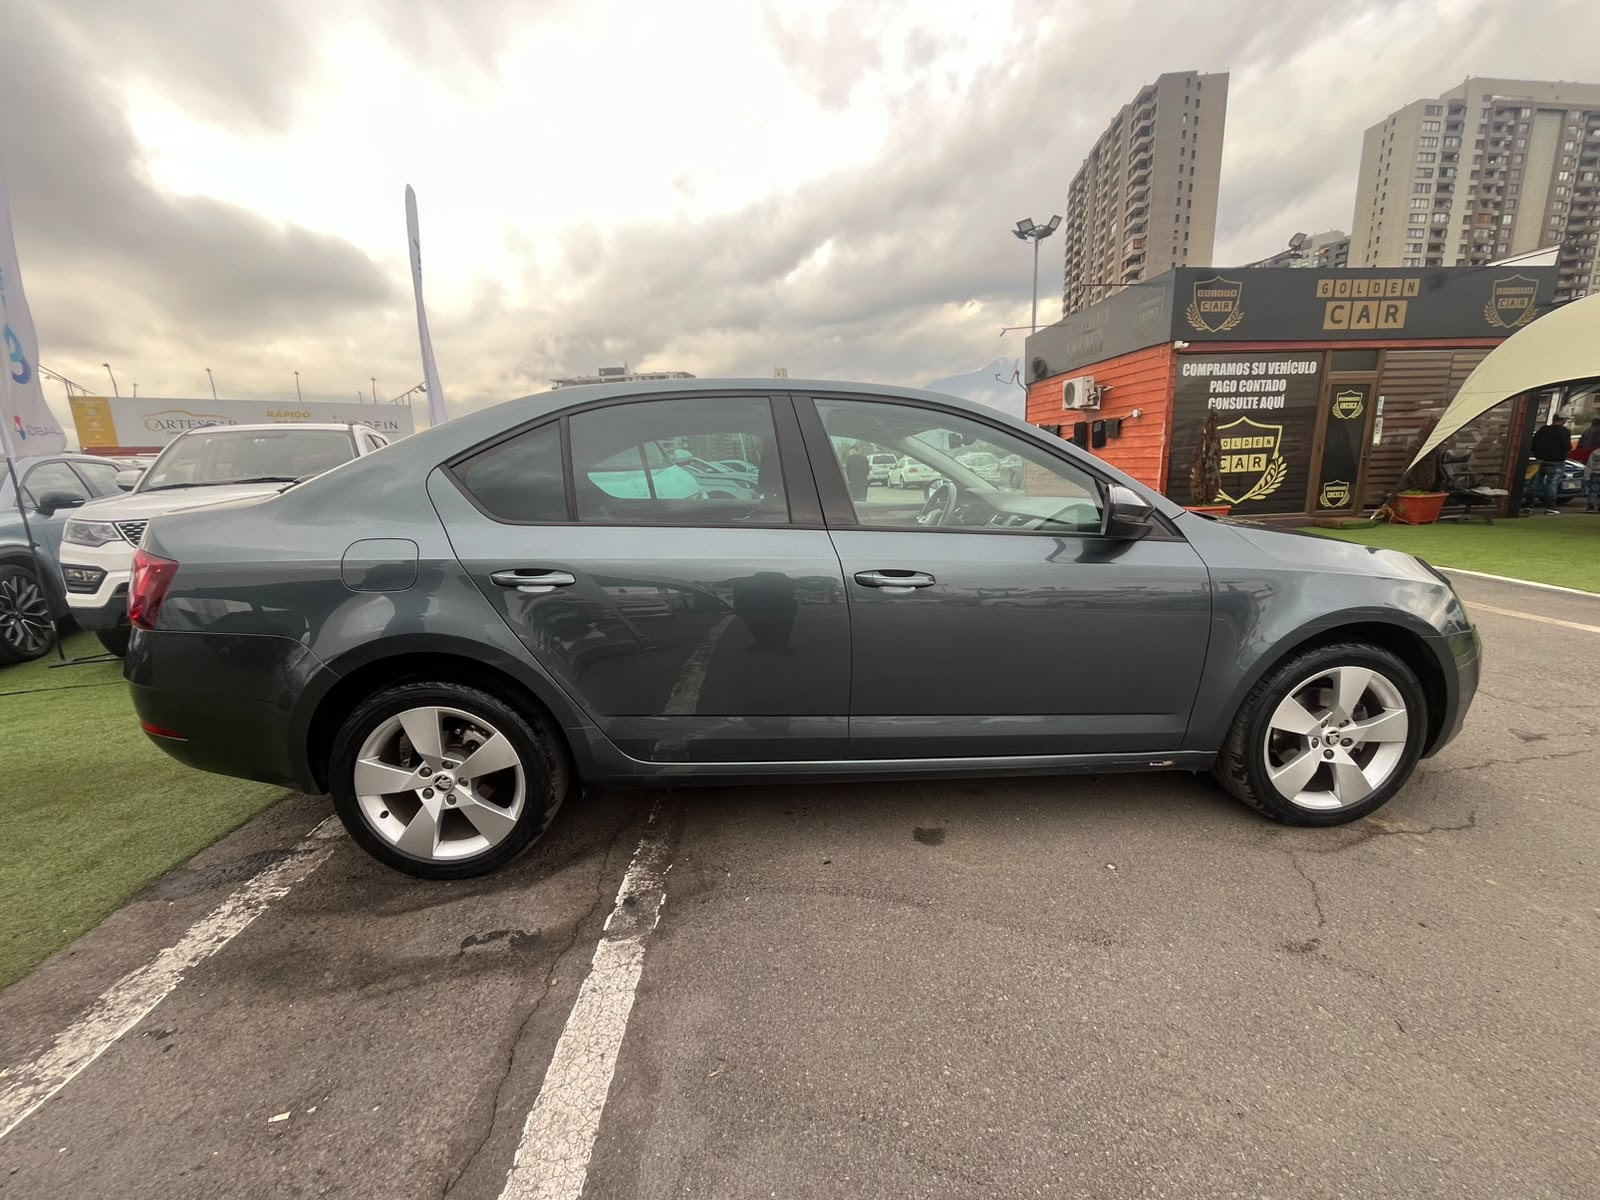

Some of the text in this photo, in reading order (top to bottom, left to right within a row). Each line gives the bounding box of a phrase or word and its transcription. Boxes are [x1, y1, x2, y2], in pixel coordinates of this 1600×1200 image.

[1320, 281, 1417, 295] GOLDEN
[1201, 301, 1230, 311] CAR
[1329, 303, 1400, 325] CAR
[1182, 360, 1317, 376] COMPRAMOS SU VEHÍCULO
[1209, 379, 1287, 393] PAGO CONTADO
[1208, 394, 1286, 410] CONSULTE AQUÍ
[266, 408, 311, 418] RÁPIDO
[1222, 437, 1273, 447] OLDEN
